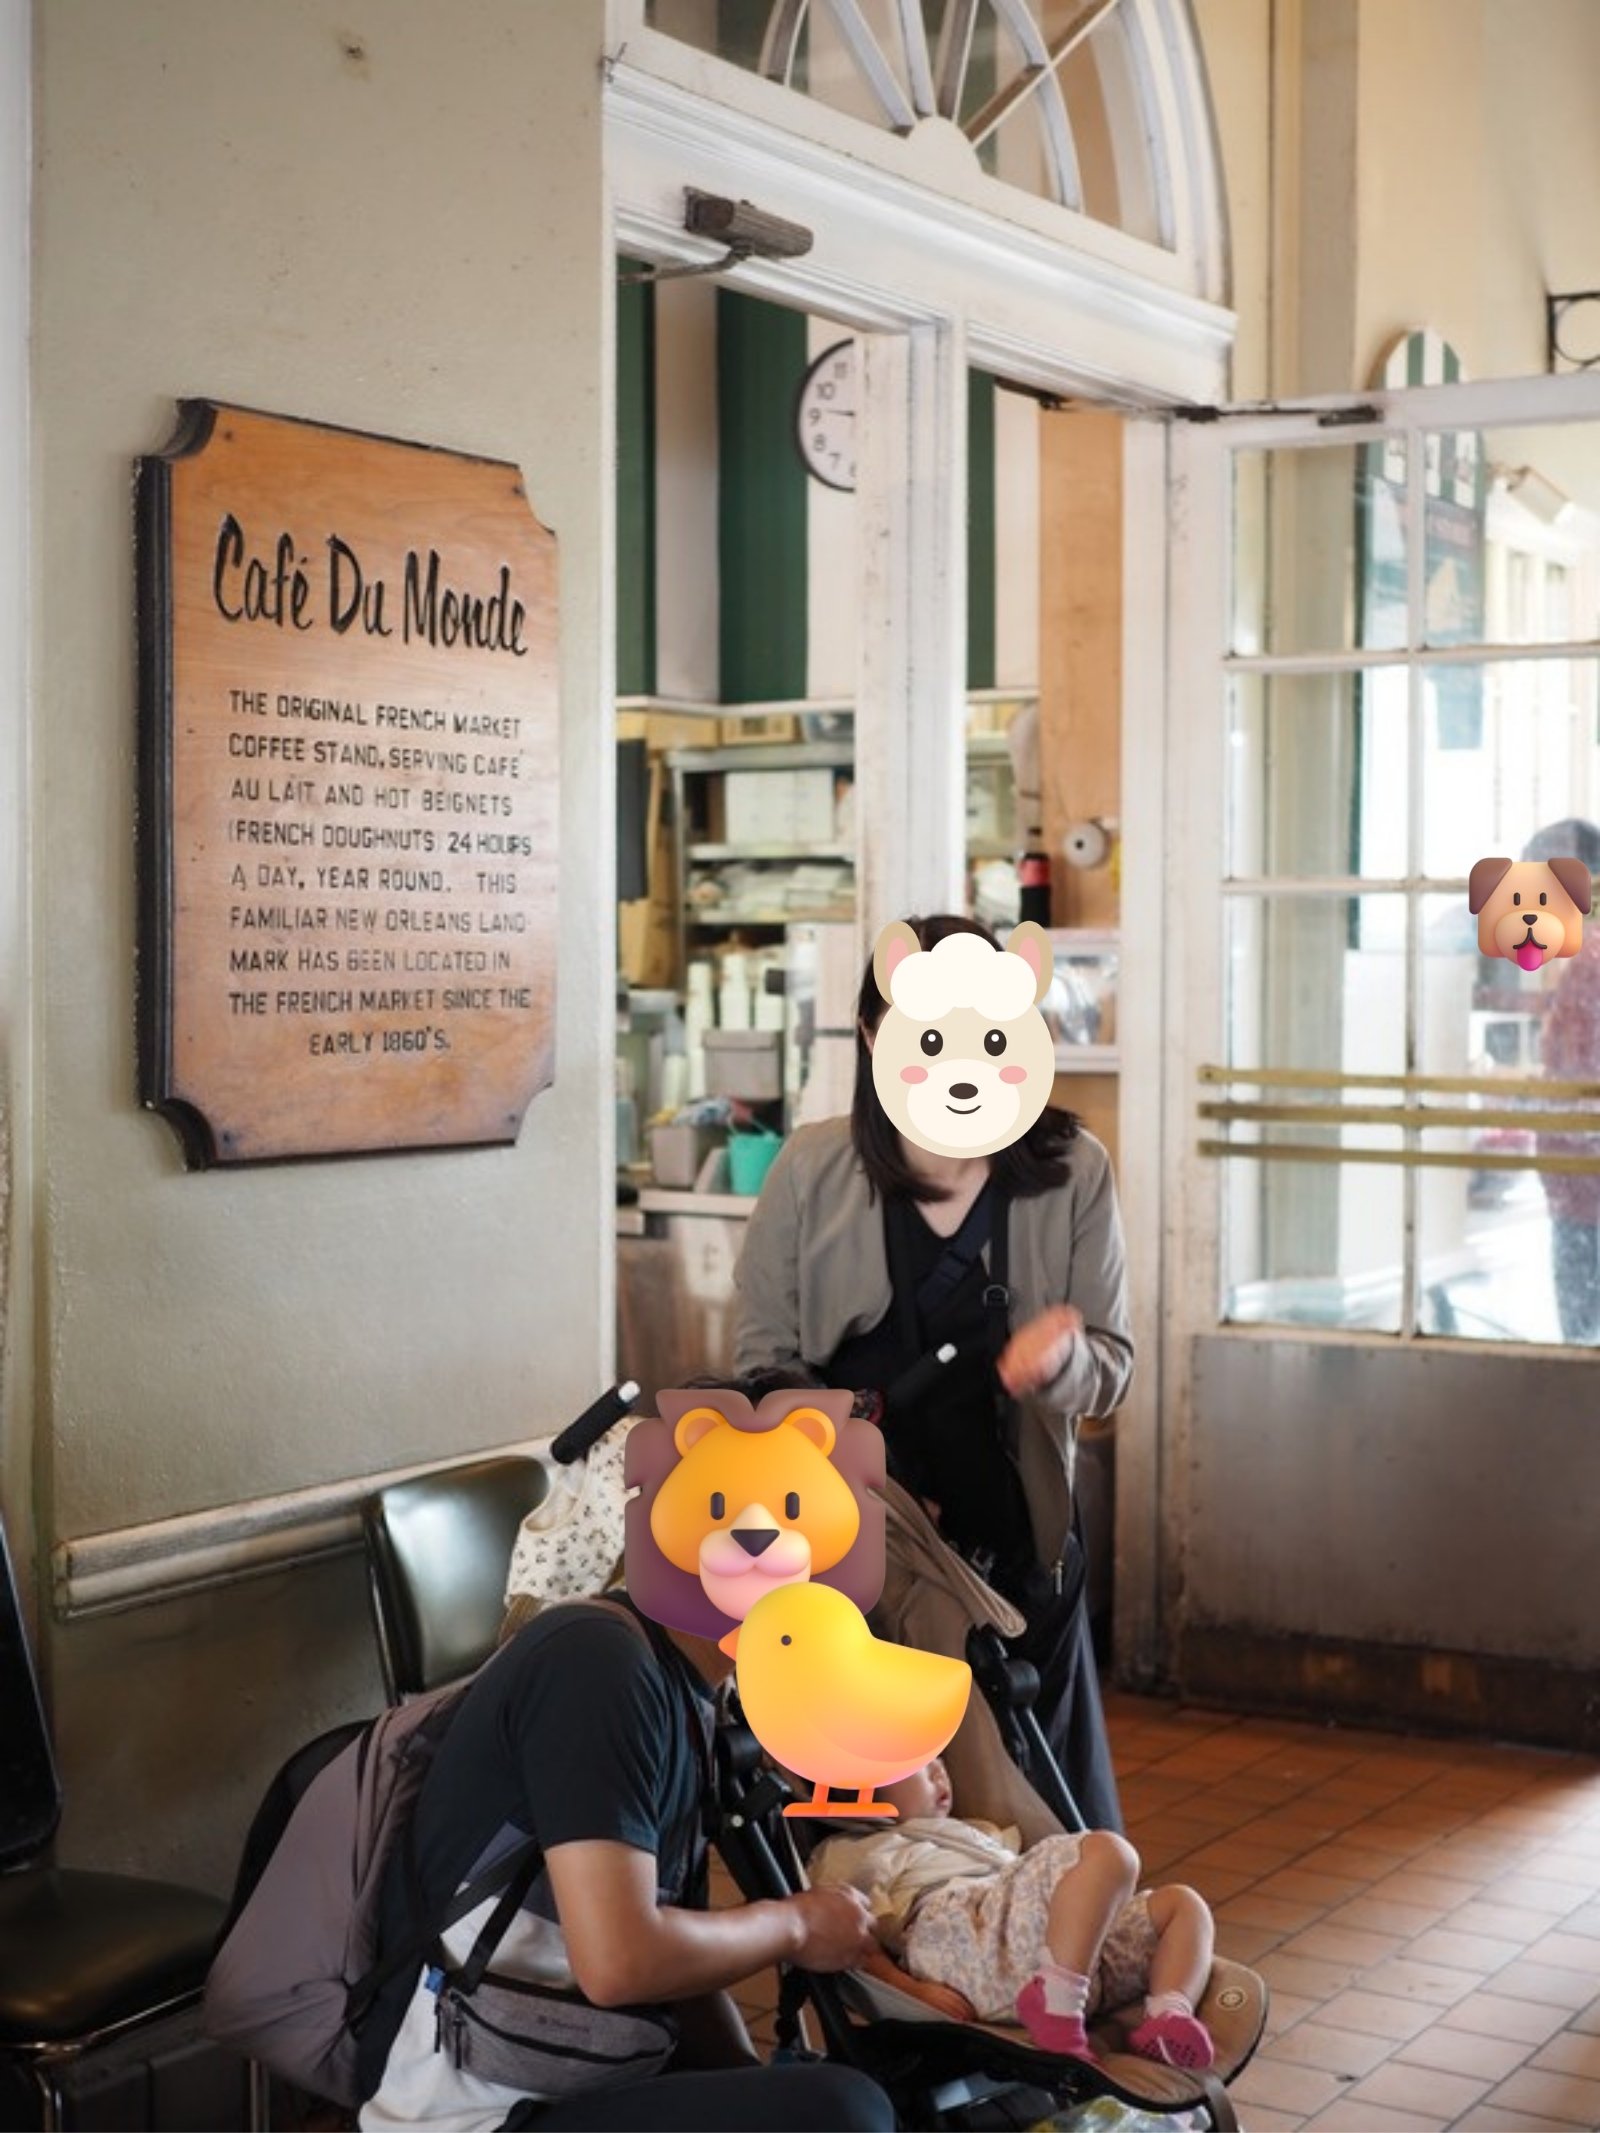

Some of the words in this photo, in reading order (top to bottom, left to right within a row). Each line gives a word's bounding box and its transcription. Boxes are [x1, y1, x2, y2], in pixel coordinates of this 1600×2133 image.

[808, 407, 821, 426] 9
[828, 452, 841, 470] 7
[214, 513, 313, 631] Café
[326, 533, 393, 635] Du
[402, 549, 529, 657] Monde
[229, 690, 268, 715] THE
[277, 695, 368, 725] ORIGINAL
[376, 705, 446, 732] FRENCH
[453, 713, 521, 739] MARKET
[229, 732, 305, 761] COFFEE
[231, 777, 260, 801] AU
[269, 780, 315, 802] LAIT
[325, 783, 363, 806] AND
[374, 786, 411, 809] HOT
[422, 788, 513, 817] BEIGNETS
[448, 830, 472, 854] 24
[231, 863, 247, 891] A
[317, 866, 369, 889] YEAR
[379, 868, 451, 892] ROUND.
[477, 871, 517, 894] THIS
[229, 906, 327, 931] FAMILIAR
[336, 908, 377, 932] NEW
[386, 909, 472, 933] ORLEANS
[229, 949, 289, 972] MARK
[298, 948, 339, 972] HAS
[347, 949, 395, 972] BEEN
[403, 950, 486, 972] LOCATED
[493, 951, 511, 972] IN
[229, 991, 268, 1015] THE
[277, 990, 352, 1015] FRENCH
[360, 989, 435, 1012] MARKET
[442, 988, 492, 1010] SINCE
[499, 987, 532, 1009] THE
[309, 1031, 373, 1056] EARLY
